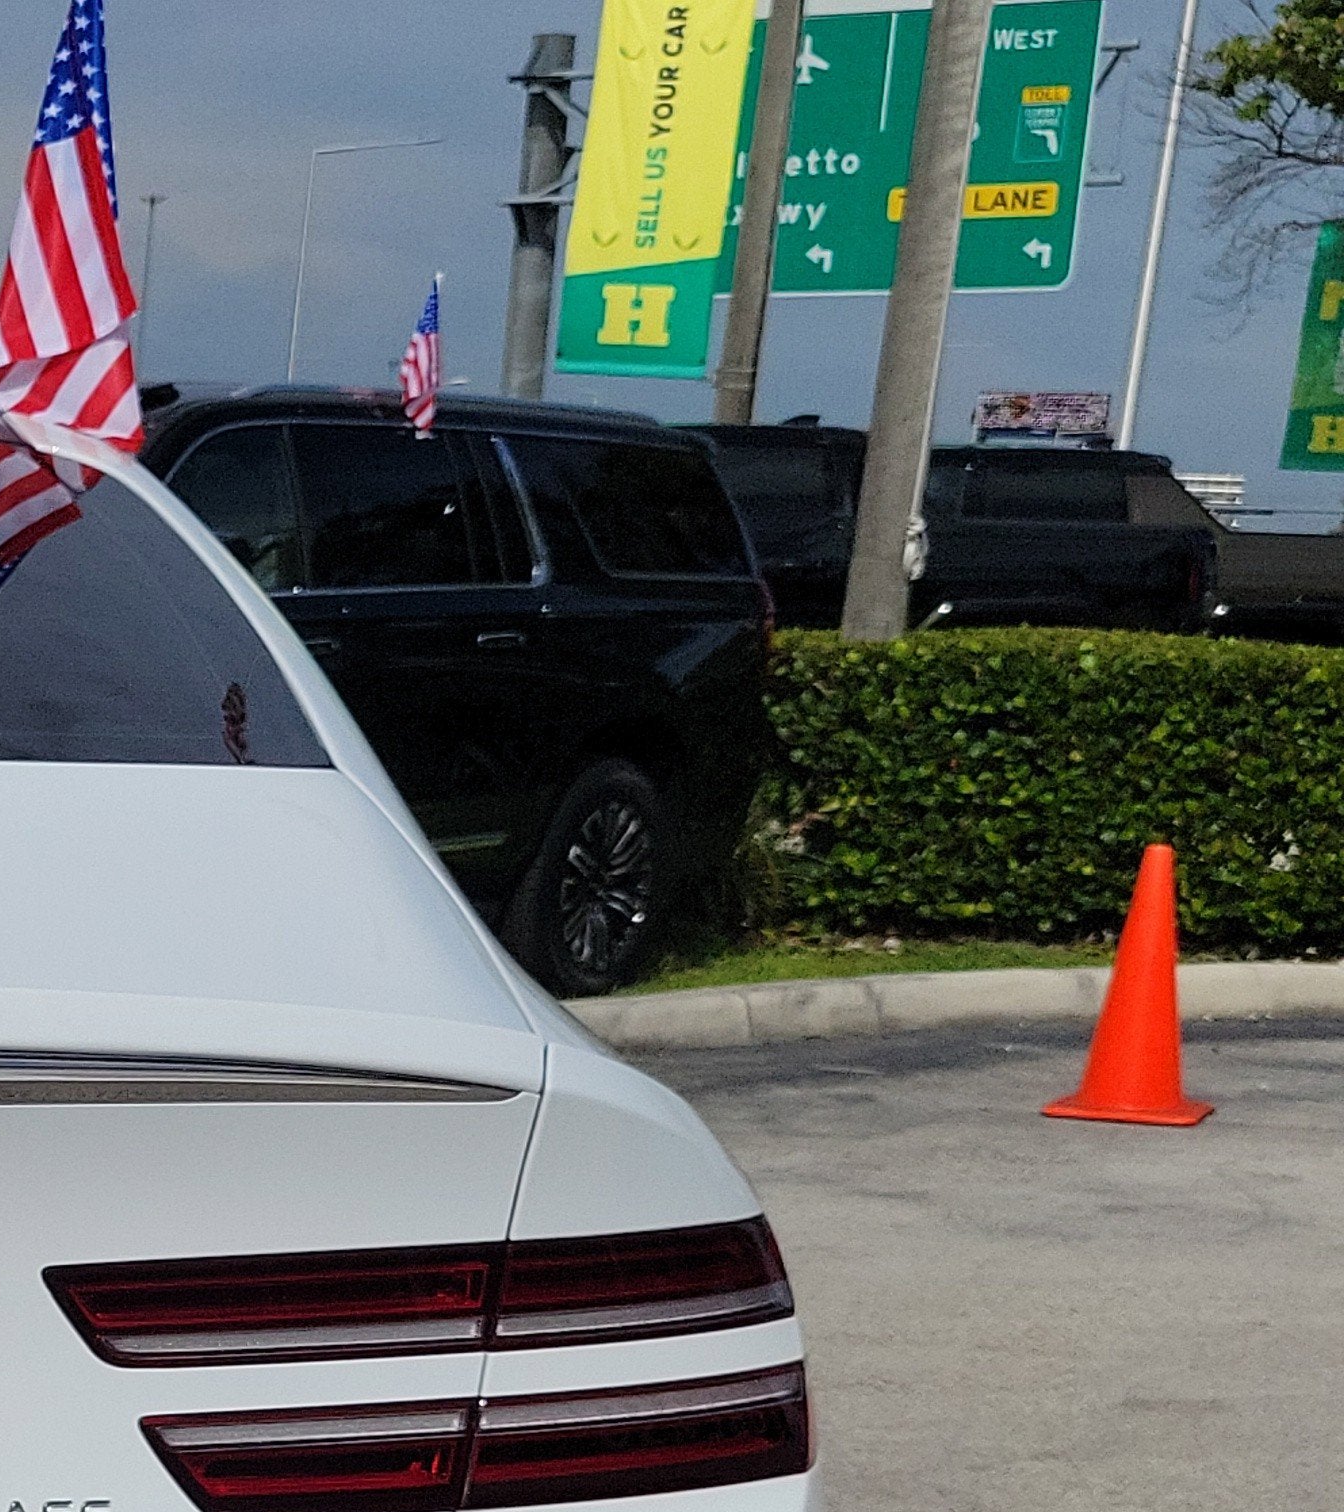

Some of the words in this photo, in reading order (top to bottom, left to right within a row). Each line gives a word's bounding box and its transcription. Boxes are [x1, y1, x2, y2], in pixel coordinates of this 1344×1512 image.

[663, 5, 689, 57] CAR
[993, 28, 1058, 50] WEST
[649, 66, 679, 138] YOUR
[646, 147, 667, 182] US
[737, 147, 861, 179] letto
[635, 191, 662, 248] SELL
[973, 188, 1048, 212] LANE
[596, 282, 677, 347] H
